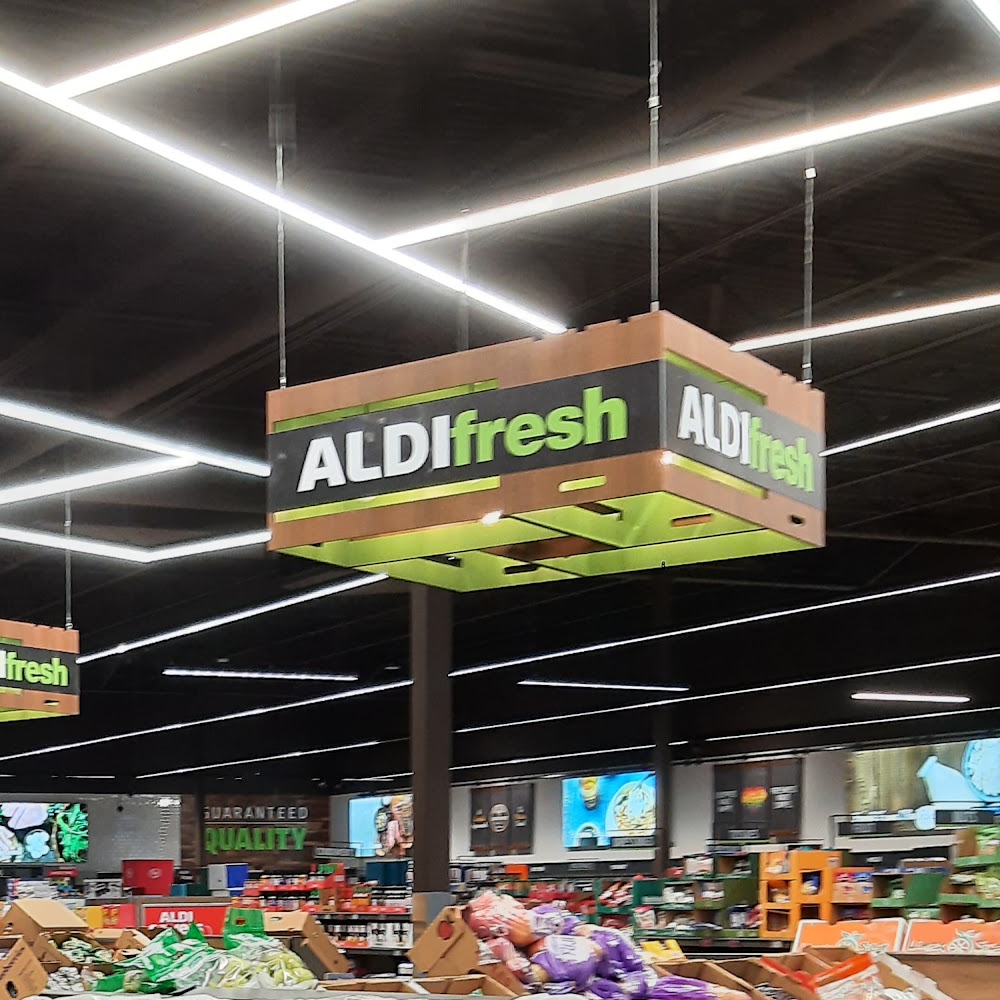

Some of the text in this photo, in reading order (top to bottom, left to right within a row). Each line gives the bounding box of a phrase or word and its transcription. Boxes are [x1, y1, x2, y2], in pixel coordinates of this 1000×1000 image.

[297, 386, 629, 492] ALDIfresh
[677, 384, 815, 492] ALDIfresh
[205, 827, 307, 855] QUALITY
[159, 910, 194, 923] ALDI
